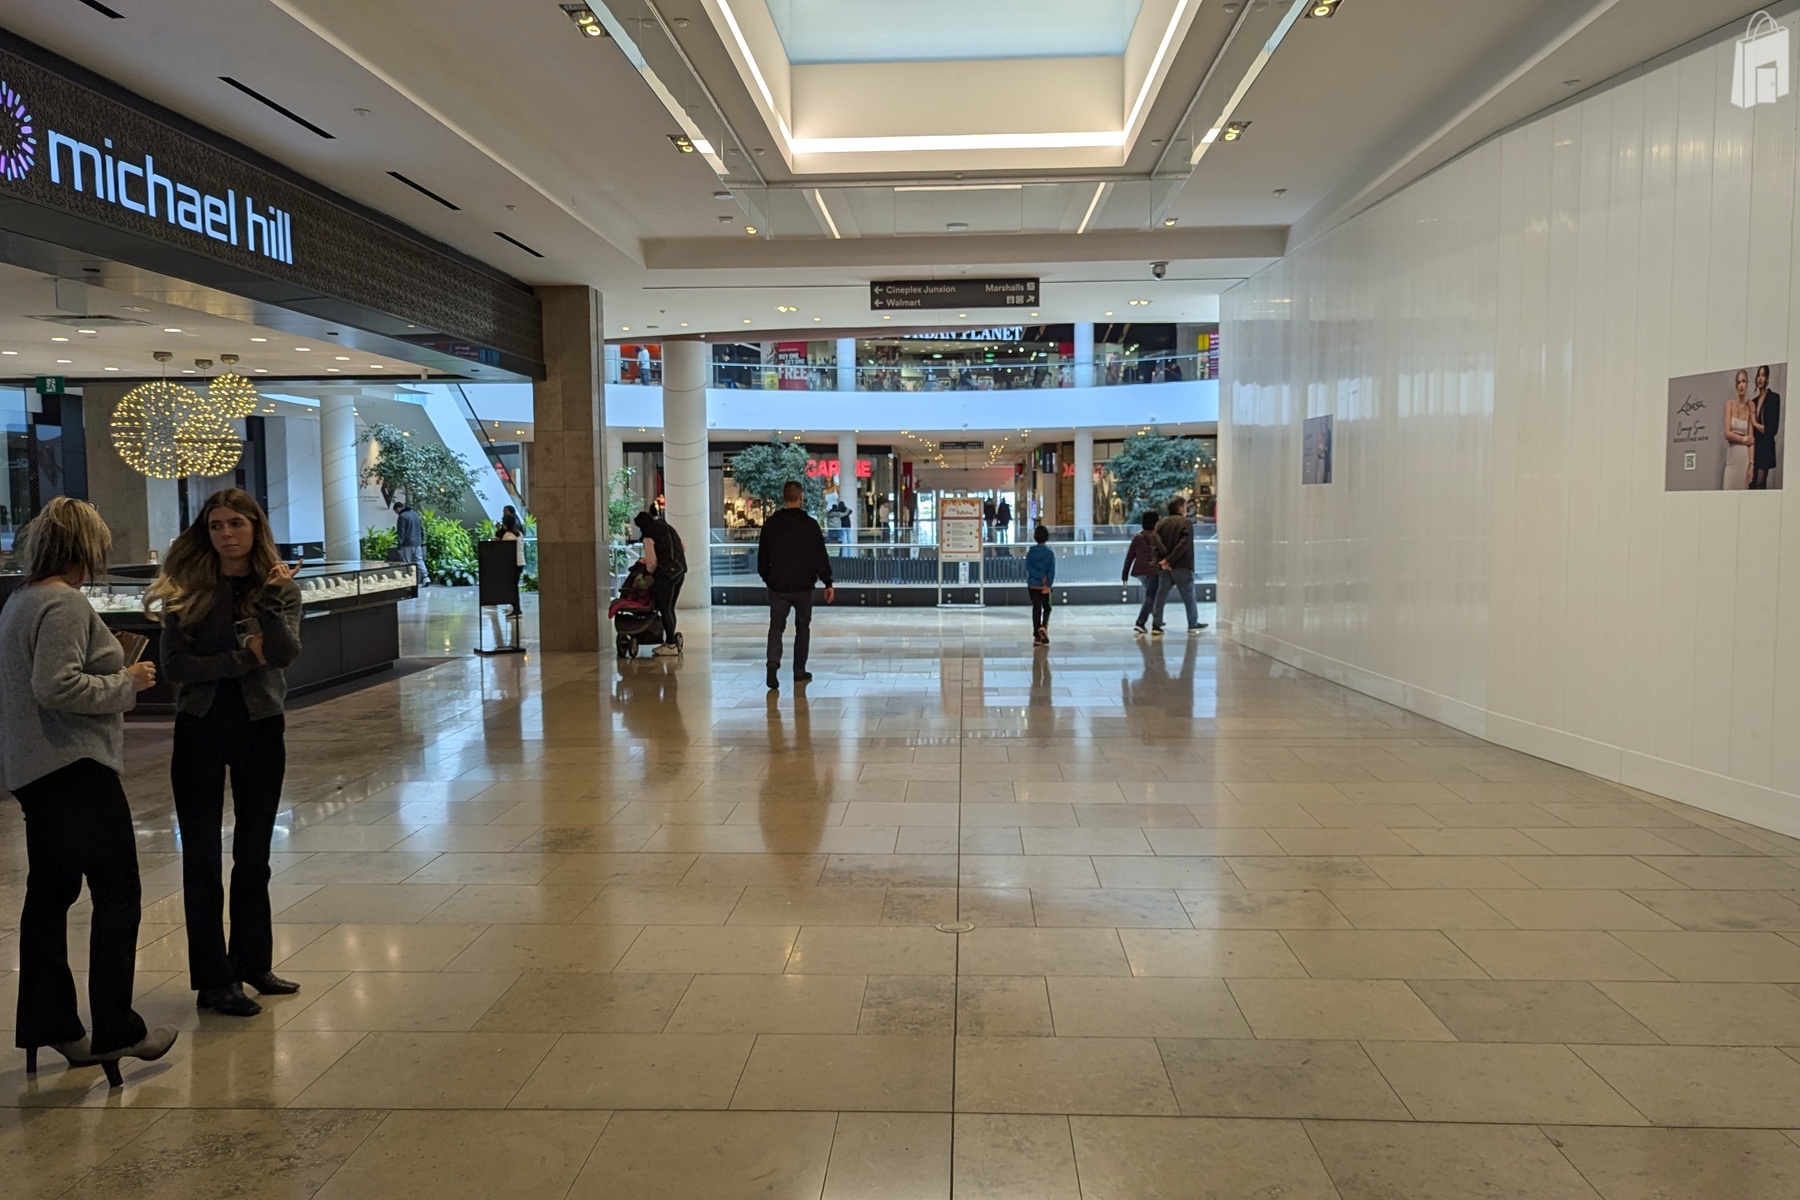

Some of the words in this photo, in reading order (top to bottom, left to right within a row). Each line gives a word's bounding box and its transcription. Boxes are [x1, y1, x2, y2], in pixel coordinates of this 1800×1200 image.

[48, 129, 237, 246] michael
[246, 196, 293, 266] hill
[886, 285, 922, 295] Cineplex
[923, 284, 956, 294] Junxion
[985, 283, 1025, 292] Marshalls
[886, 298, 921, 307] Walmart
[960, 325, 1024, 341] PLANET
[778, 367, 807, 380] FREE
[805, 458, 872, 478] GARE
